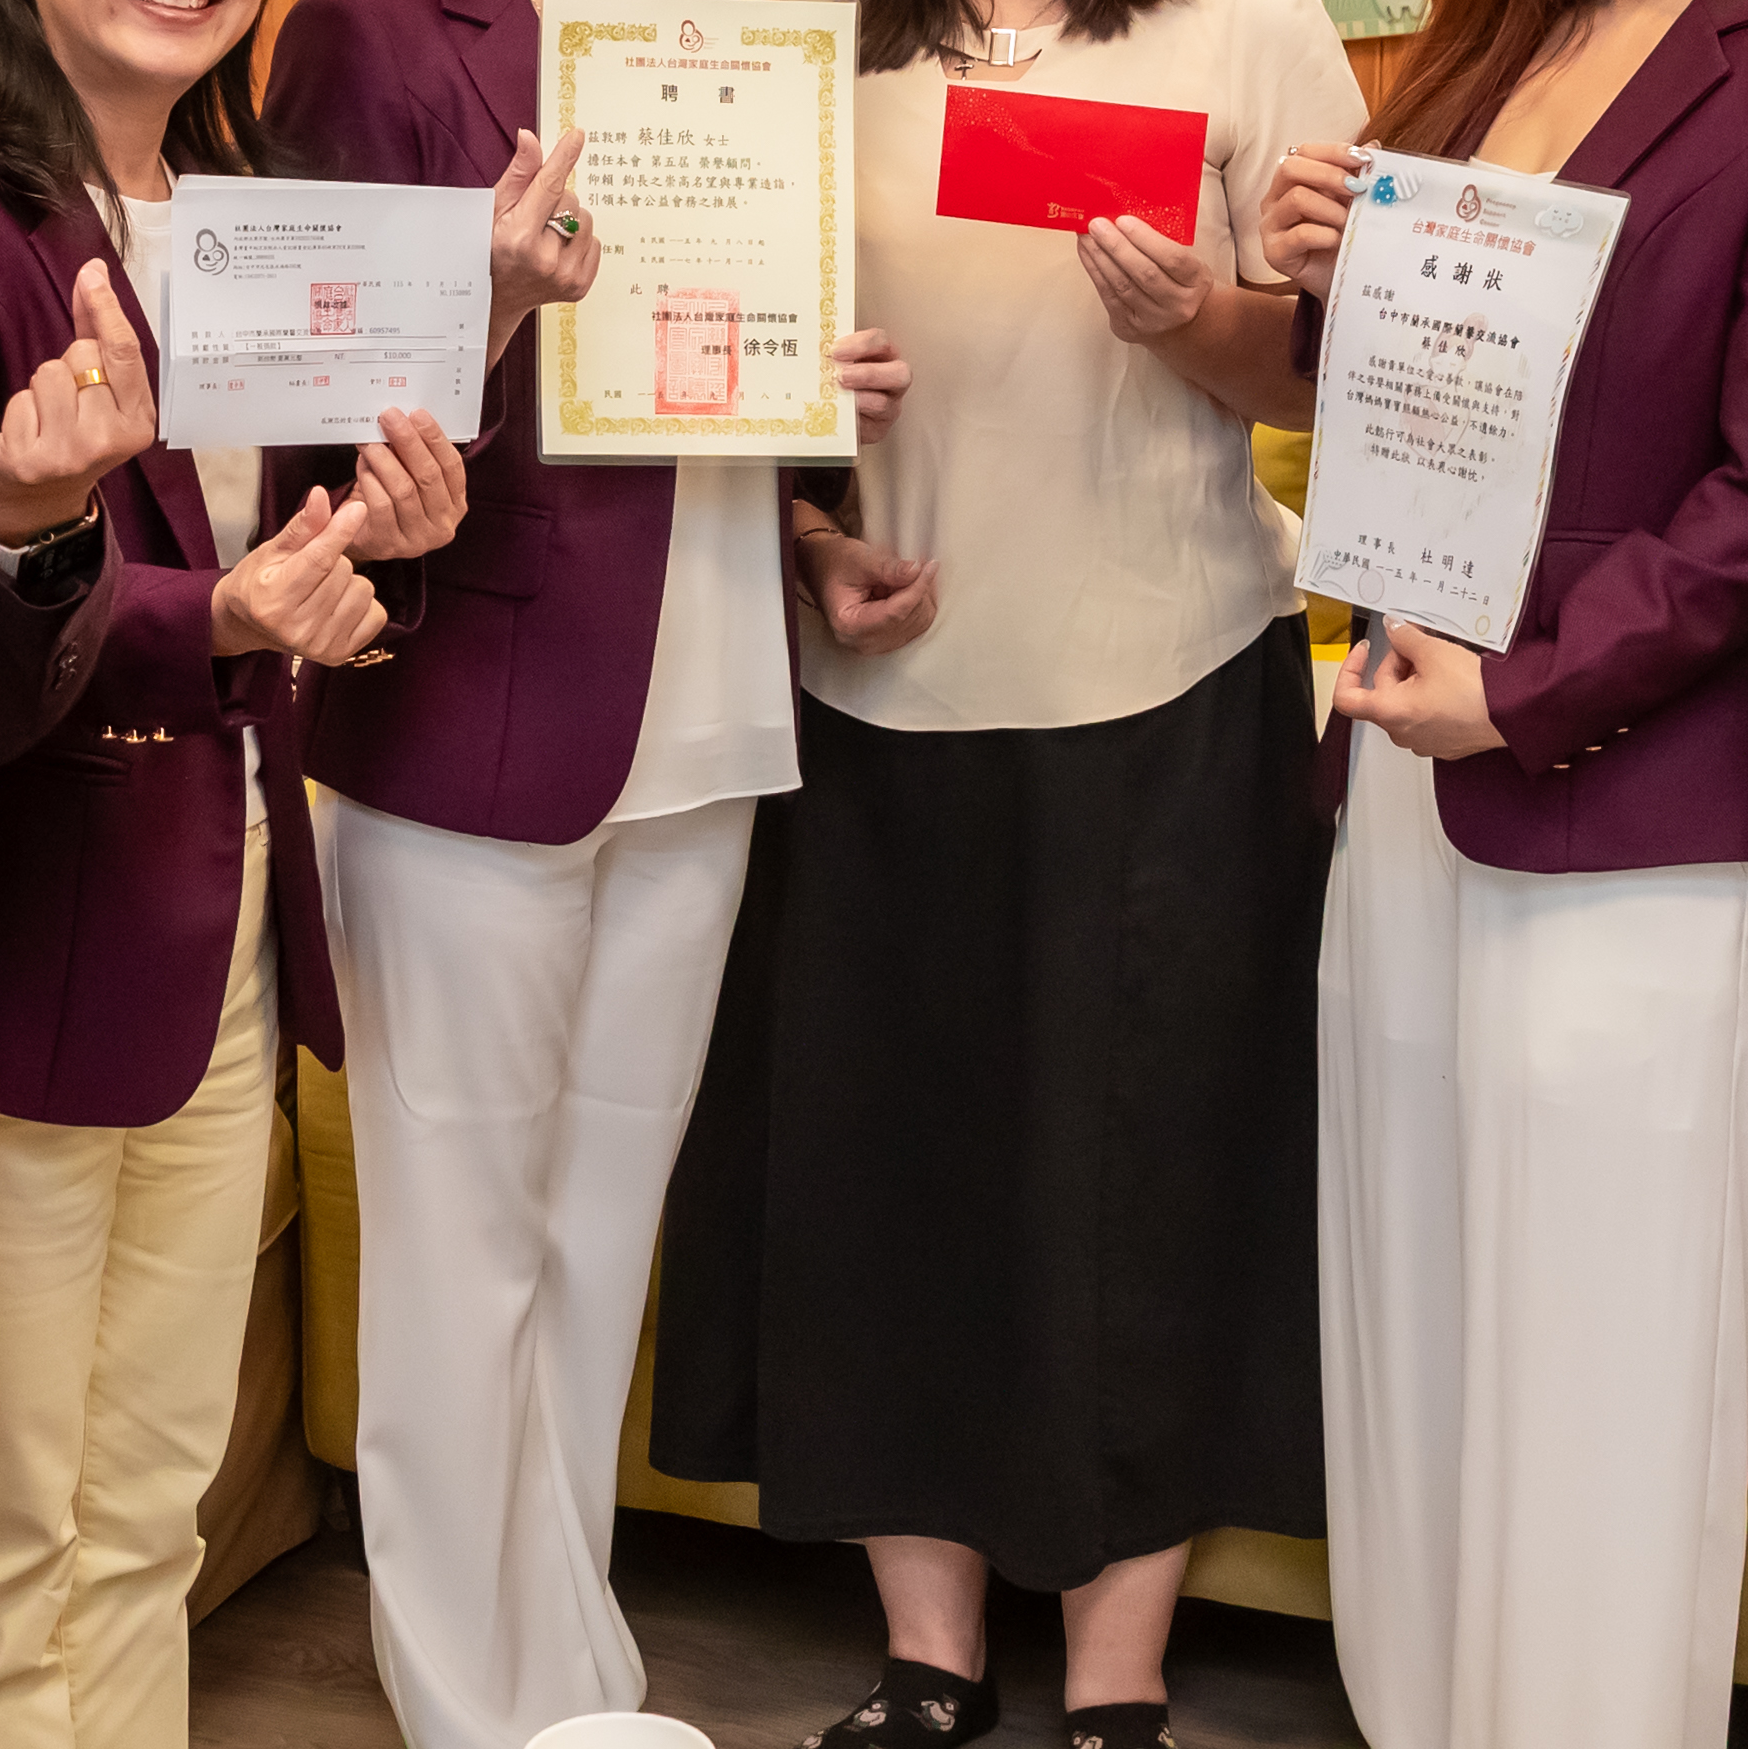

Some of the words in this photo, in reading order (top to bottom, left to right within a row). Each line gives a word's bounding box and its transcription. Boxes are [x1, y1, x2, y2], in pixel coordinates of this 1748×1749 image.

[625, 56, 772, 72] 社團法人台灣家庭生命關懷協會
[638, 127, 696, 147] 蔡佳欣
[703, 133, 730, 147] 女士
[1412, 217, 1537, 257] 台灣家庭生命關懷協會
[1420, 254, 1503, 292] 感謝狀
[1358, 534, 1396, 555] 理事長
